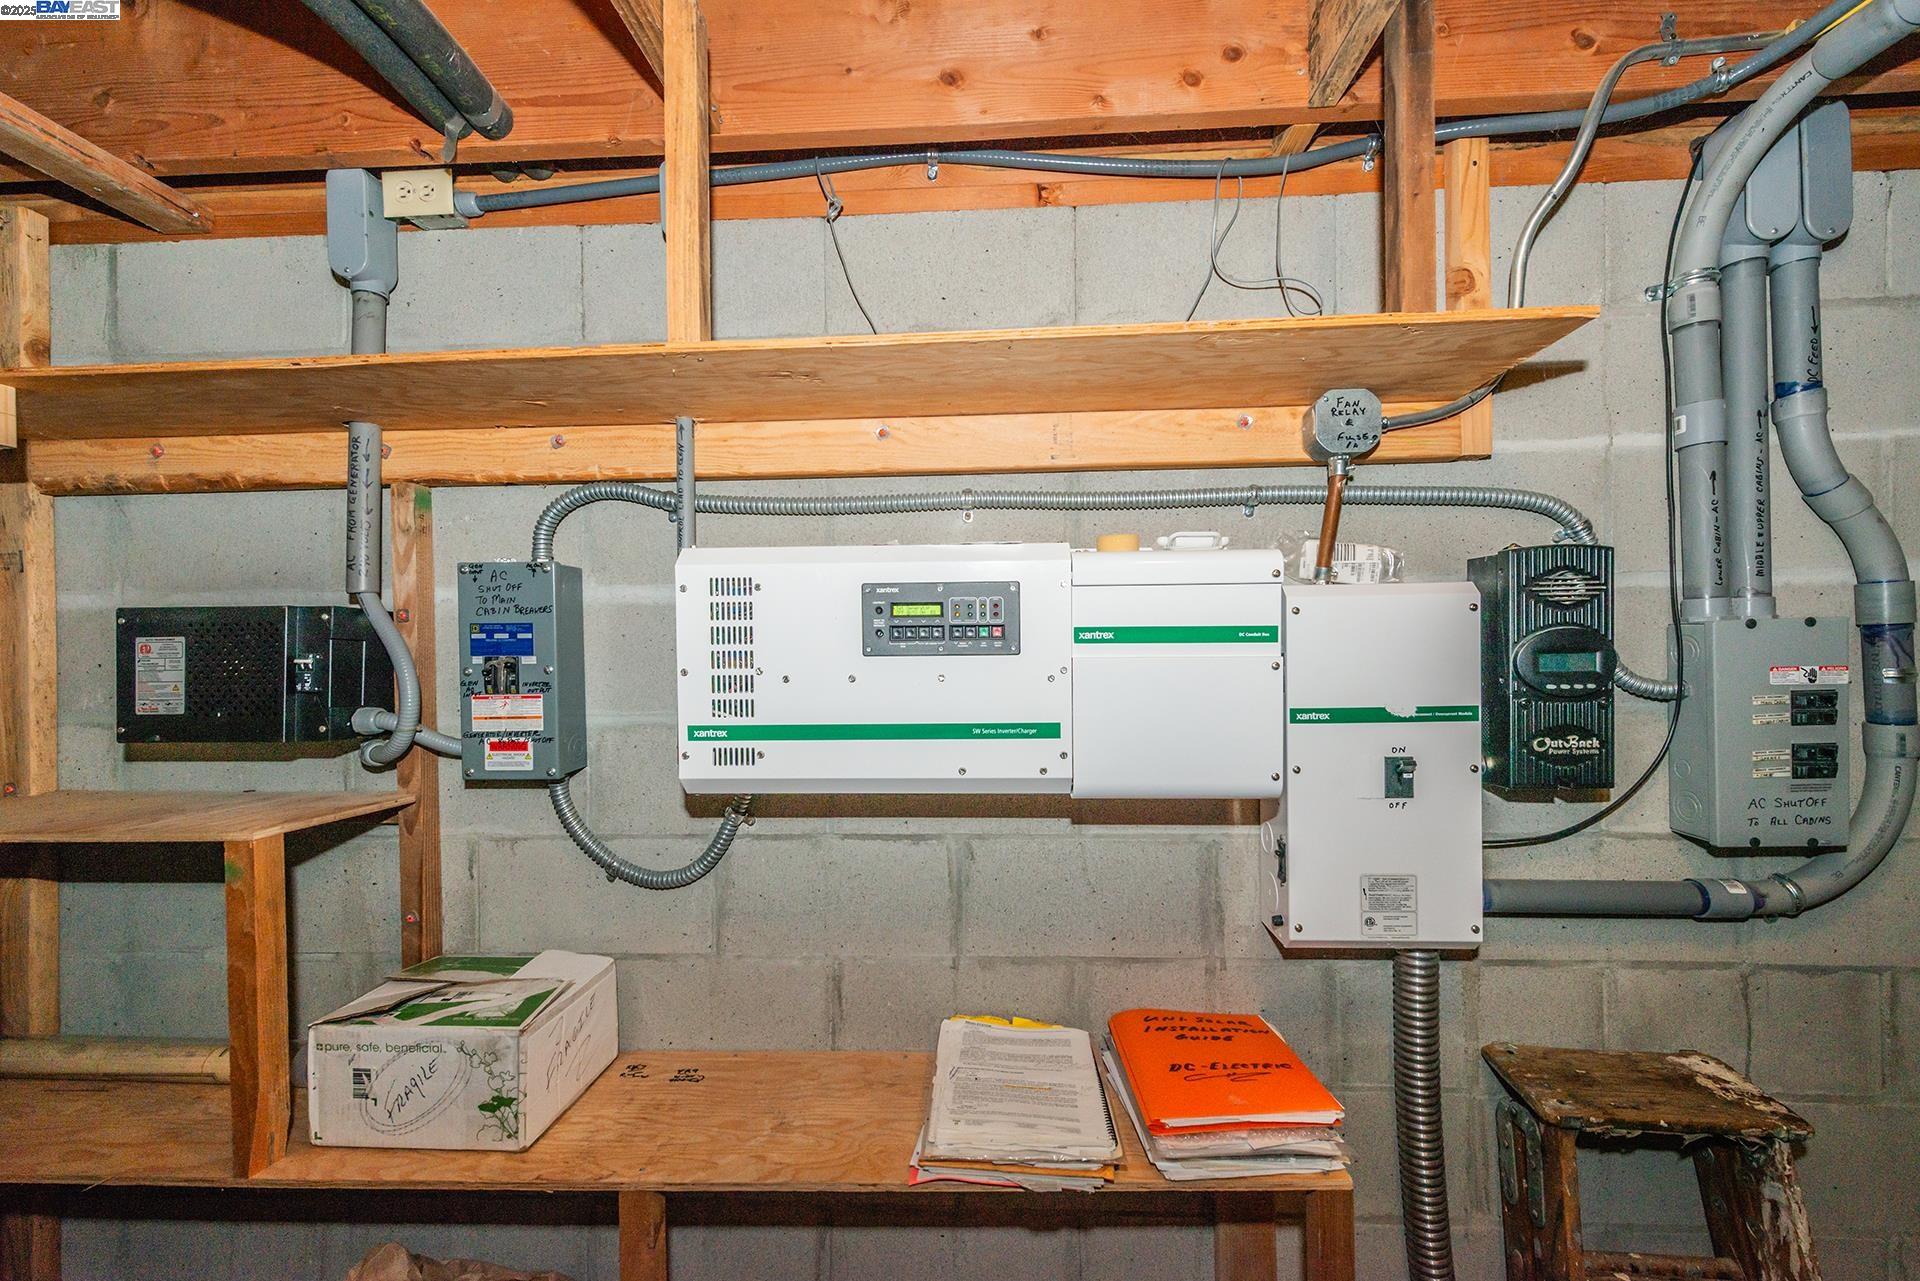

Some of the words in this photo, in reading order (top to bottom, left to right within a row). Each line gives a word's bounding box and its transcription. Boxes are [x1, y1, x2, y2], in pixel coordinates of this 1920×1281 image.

[1807, 338, 1818, 365] FEED
[1807, 369, 1819, 383] DC
[1336, 396, 1360, 408] FAN
[1331, 407, 1366, 417] RELAY
[1337, 432, 1369, 441] FUSE
[349, 435, 361, 505] GENERATOR
[679, 469, 684, 480] TO
[1755, 457, 1764, 492] CABINS
[1756, 499, 1765, 530] UPPER
[347, 510, 357, 541] FROM
[346, 554, 356, 571] AC
[1755, 541, 1765, 577] MIDDLE
[490, 570, 508, 582] AC
[1714, 559, 1723, 585] LOWER
[478, 585, 501, 593] SHUT
[505, 583, 523, 592] OFF
[475, 595, 488, 605] TO
[492, 594, 516, 605] MAIN
[475, 607, 510, 616] CABIN
[1079, 630, 1114, 640] xantrex
[1296, 712, 1330, 720] xantrex
[693, 729, 728, 738] xantrex
[1533, 735, 1600, 752] OutBack
[1391, 746, 1406, 754] ON
[1572, 748, 1599, 756] Systems
[1389, 801, 1407, 810] OFF
[1747, 798, 1766, 809] AC
[1770, 817, 1788, 826] ALL
[1794, 815, 1831, 825] CABINS
[1196, 1017, 1252, 1027] SOLAR
[1144, 1026, 1270, 1035] INSTALLATION
[1175, 1034, 1235, 1042] GUIDE
[324, 1043, 352, 1053] pure,
[356, 1042, 382, 1053] safe,
[385, 1058, 439, 1123] FRAGILE
